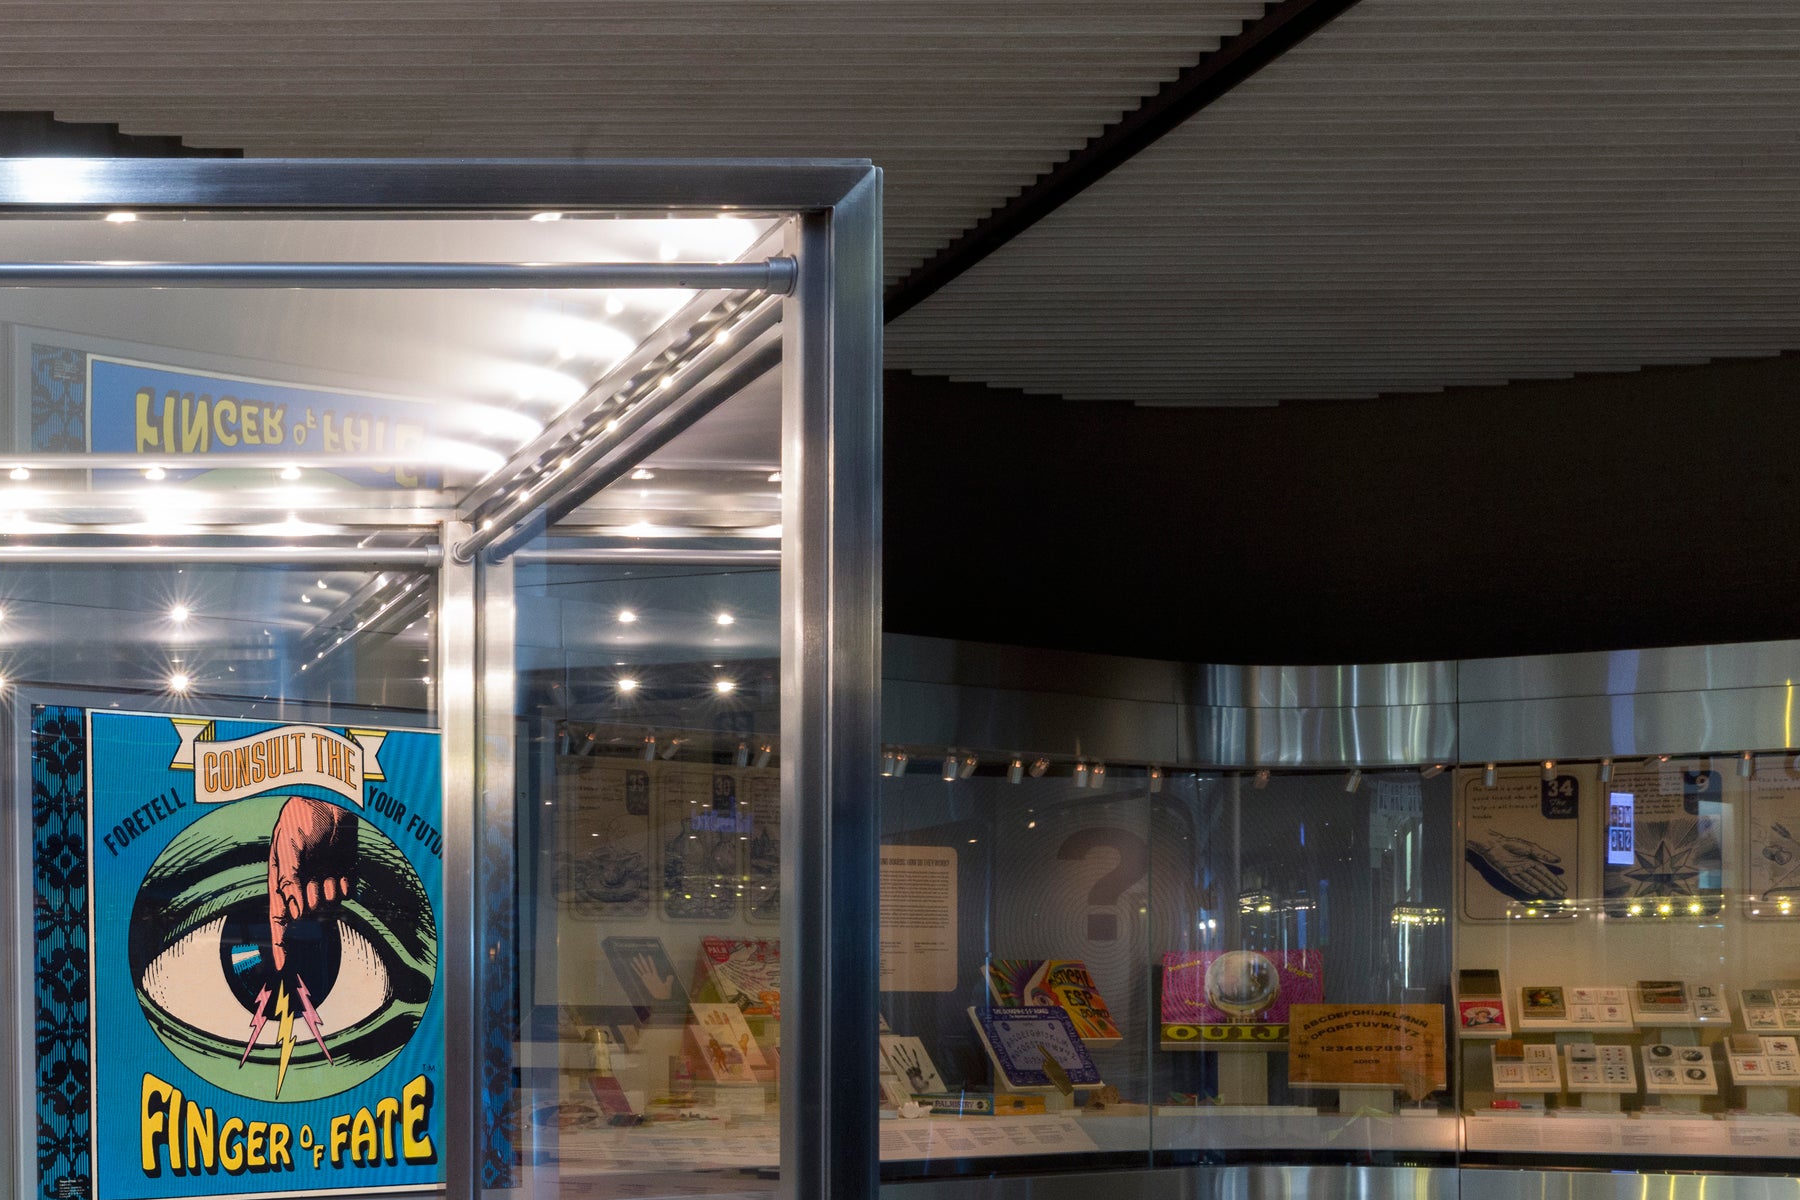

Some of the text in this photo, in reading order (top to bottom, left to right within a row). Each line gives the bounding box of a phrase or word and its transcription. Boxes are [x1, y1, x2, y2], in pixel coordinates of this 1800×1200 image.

[203, 730, 358, 793] CONSULT THE
[1548, 780, 1573, 797] 34
[1695, 775, 1710, 792] 9
[367, 785, 408, 828] YOUR
[102, 787, 187, 857] FORETELL
[1064, 990, 1093, 1007] ESP
[1167, 1026, 1289, 1040] OUIJ
[141, 1072, 439, 1178] FINGER OF FATE
